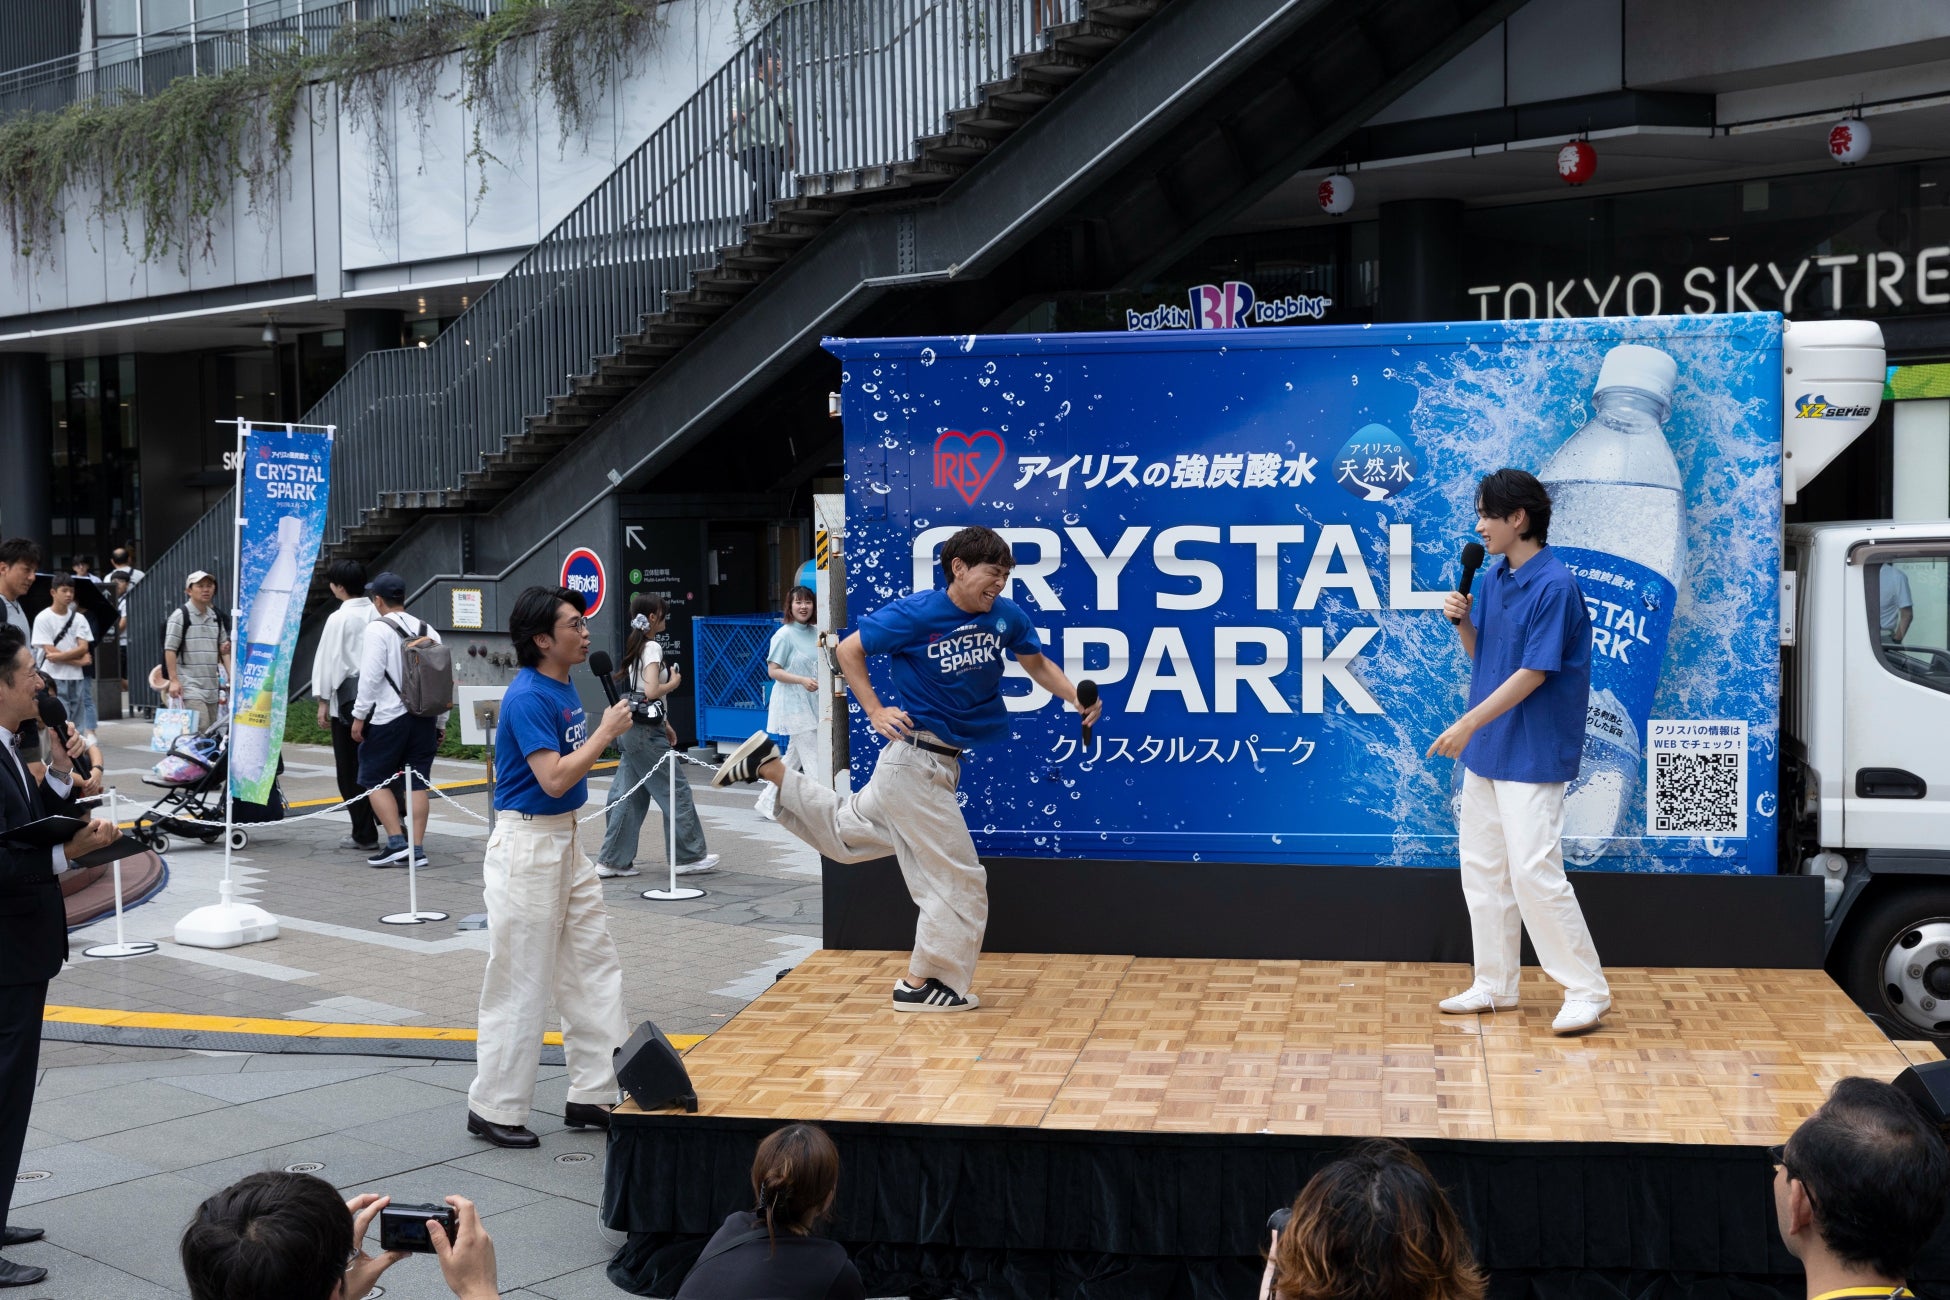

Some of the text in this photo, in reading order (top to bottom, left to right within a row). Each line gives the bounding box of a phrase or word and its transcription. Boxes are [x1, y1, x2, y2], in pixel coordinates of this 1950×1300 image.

[1188, 281, 1255, 330] BR
[1468, 270, 1662, 320] TOKYO
[1795, 403, 1871, 419] XZ series
[1349, 444, 1402, 456] アイリスの
[255, 462, 326, 483] CRYSTAL
[933, 450, 982, 488] IRIS
[1012, 453, 1318, 490] アイリスの強炭酸水
[1337, 458, 1415, 485] 天然水
[266, 481, 318, 501] SPARK
[567, 574, 599, 593] 消防水利
[1565, 562, 1637, 591] スの強炭酸水
[1583, 595, 1651, 645] STAL
[654, 633, 671, 642] きょう
[940, 645, 996, 673] SPARK
[1655, 725, 1741, 736] クリスパの情報は
[1051, 734, 1316, 766] クリスタルスパーク
